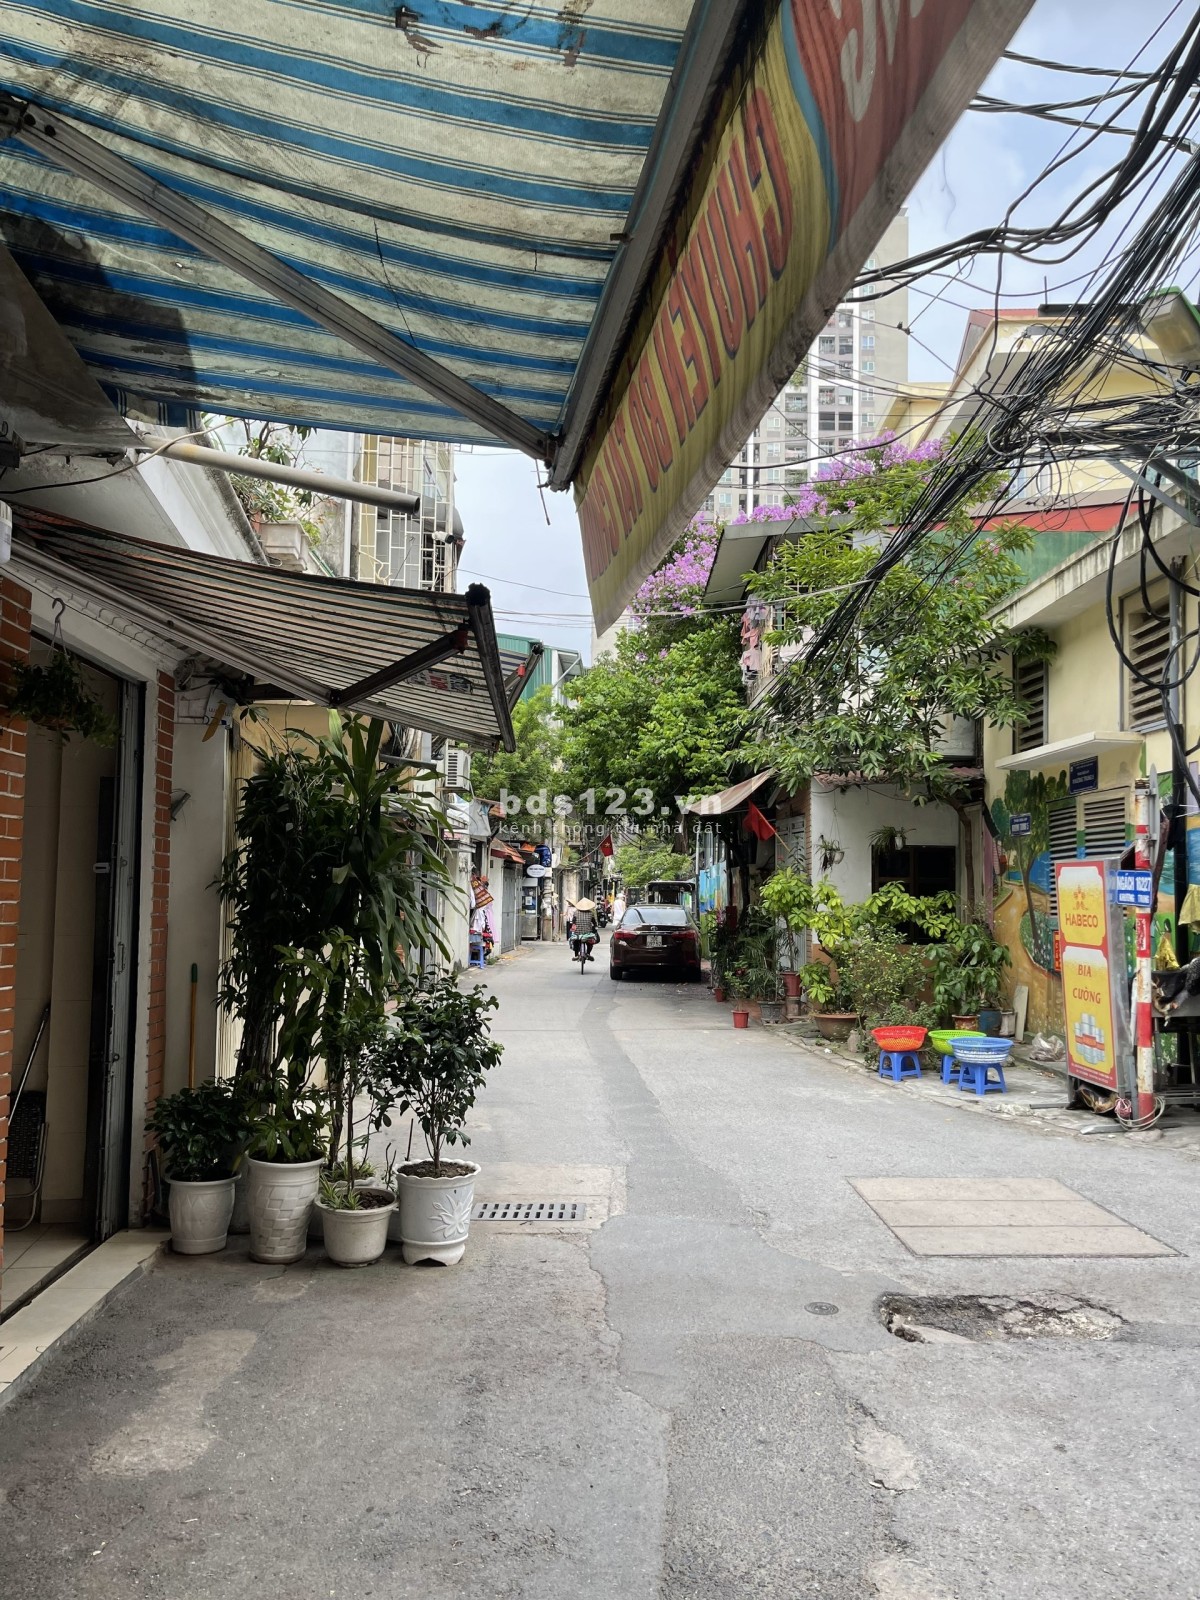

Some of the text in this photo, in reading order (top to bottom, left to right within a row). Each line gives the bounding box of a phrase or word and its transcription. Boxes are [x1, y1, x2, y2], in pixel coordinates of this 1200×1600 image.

[1065, 913, 1098, 928] HABECO
[1078, 964, 1092, 977] BIA
[1072, 987, 1101, 1004] CƯỜNG
